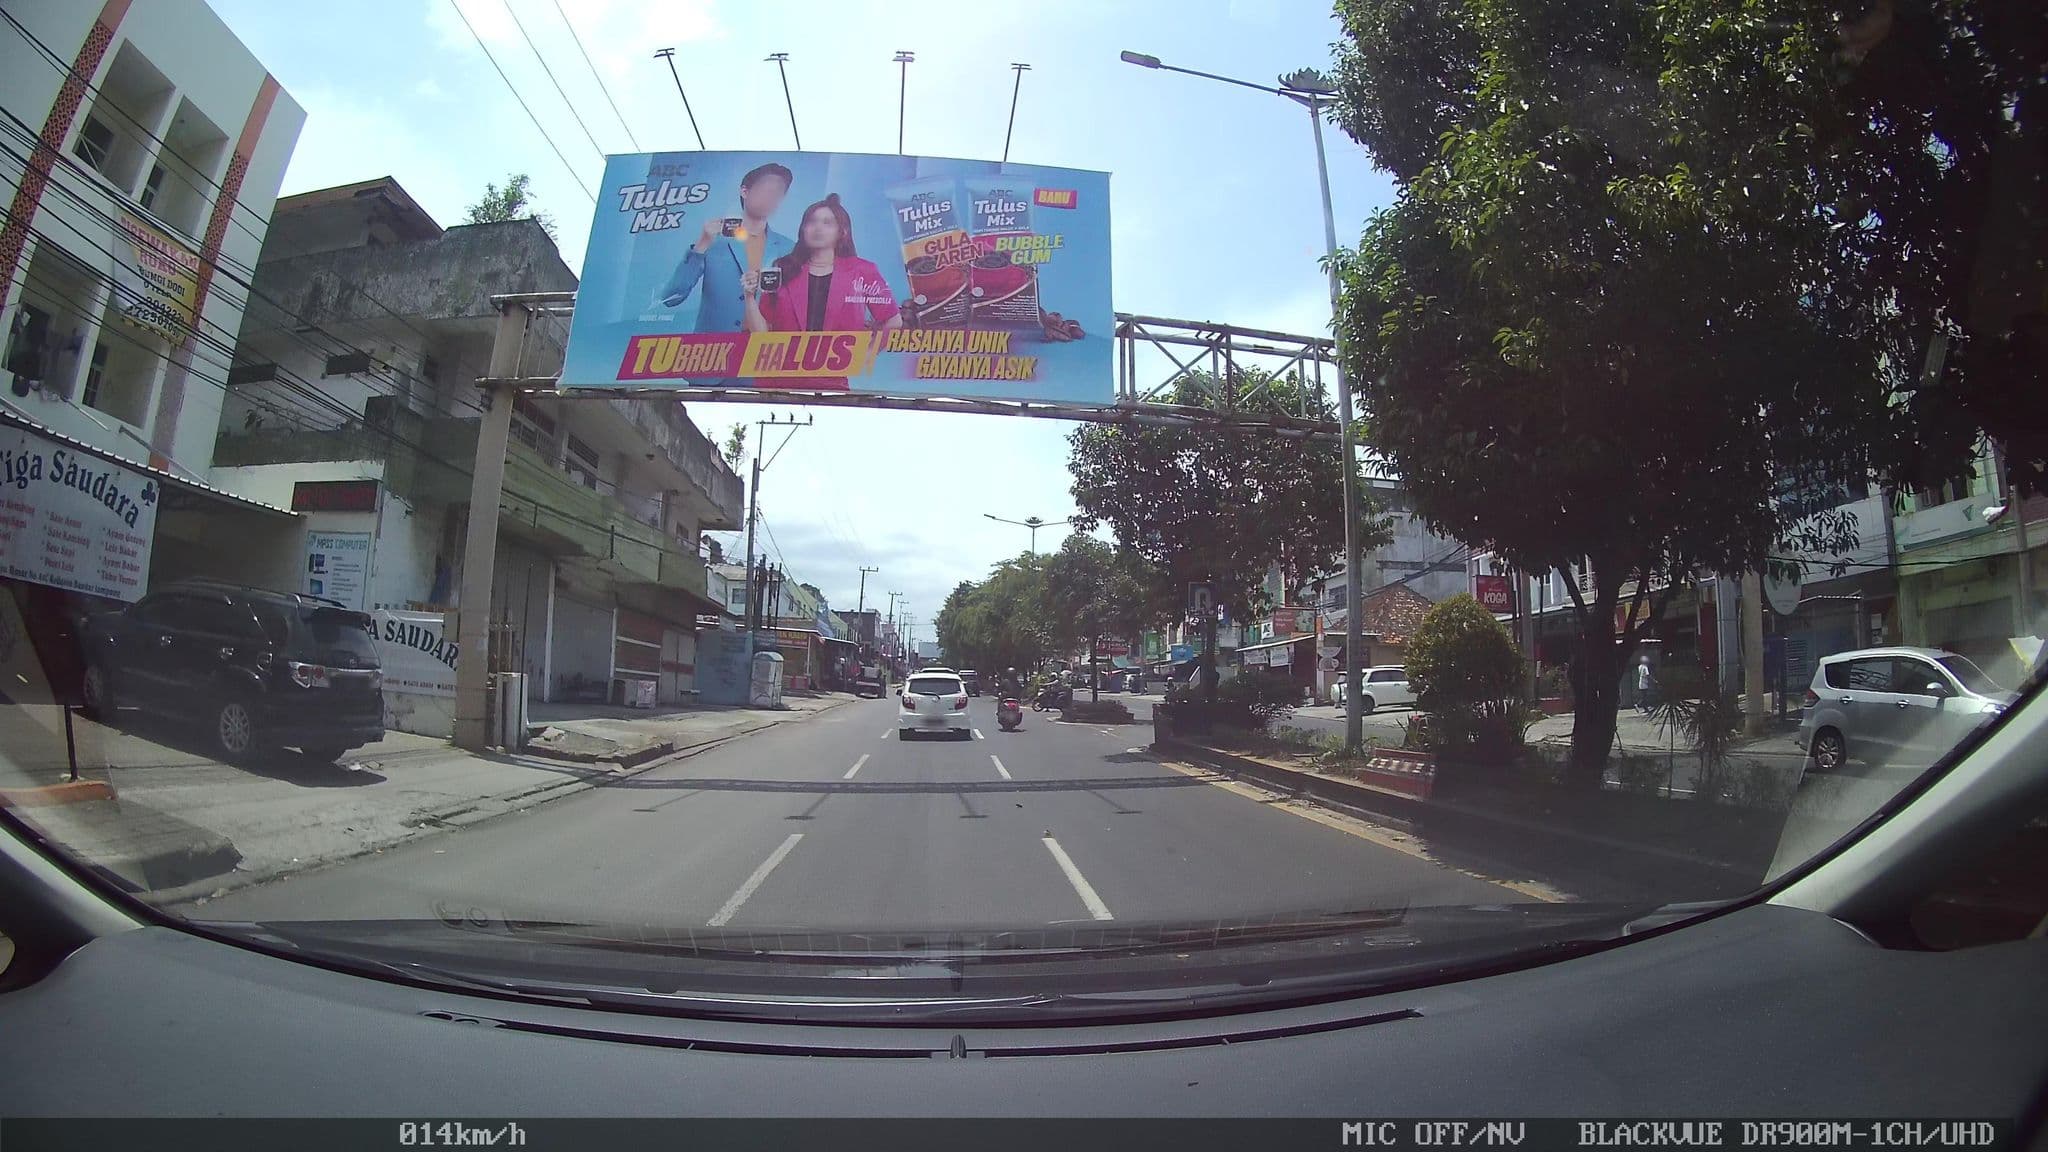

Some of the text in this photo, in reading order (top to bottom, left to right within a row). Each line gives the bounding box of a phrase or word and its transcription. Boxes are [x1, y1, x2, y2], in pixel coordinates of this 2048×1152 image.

[619, 180, 710, 212] Tulus
[974, 199, 1027, 215] Tulus
[1038, 190, 1071, 204] BARU
[630, 208, 686, 234] Mix
[898, 200, 951, 223] Tulus
[986, 214, 1015, 227] Mix
[915, 217, 943, 233] Mix
[924, 231, 972, 255] GULA
[936, 240, 985, 269] AREN
[995, 233, 1065, 252] BUBBLE
[1011, 248, 1052, 265] GUM
[754, 335, 857, 372] HALUS
[886, 329, 1011, 354] RASANYA UNIK
[632, 336, 735, 376] TUBRUK
[915, 354, 1037, 381] GAYANYA ASIK
[50, 450, 139, 528] Saudara
[384, 619, 458, 672] SAUDAR
